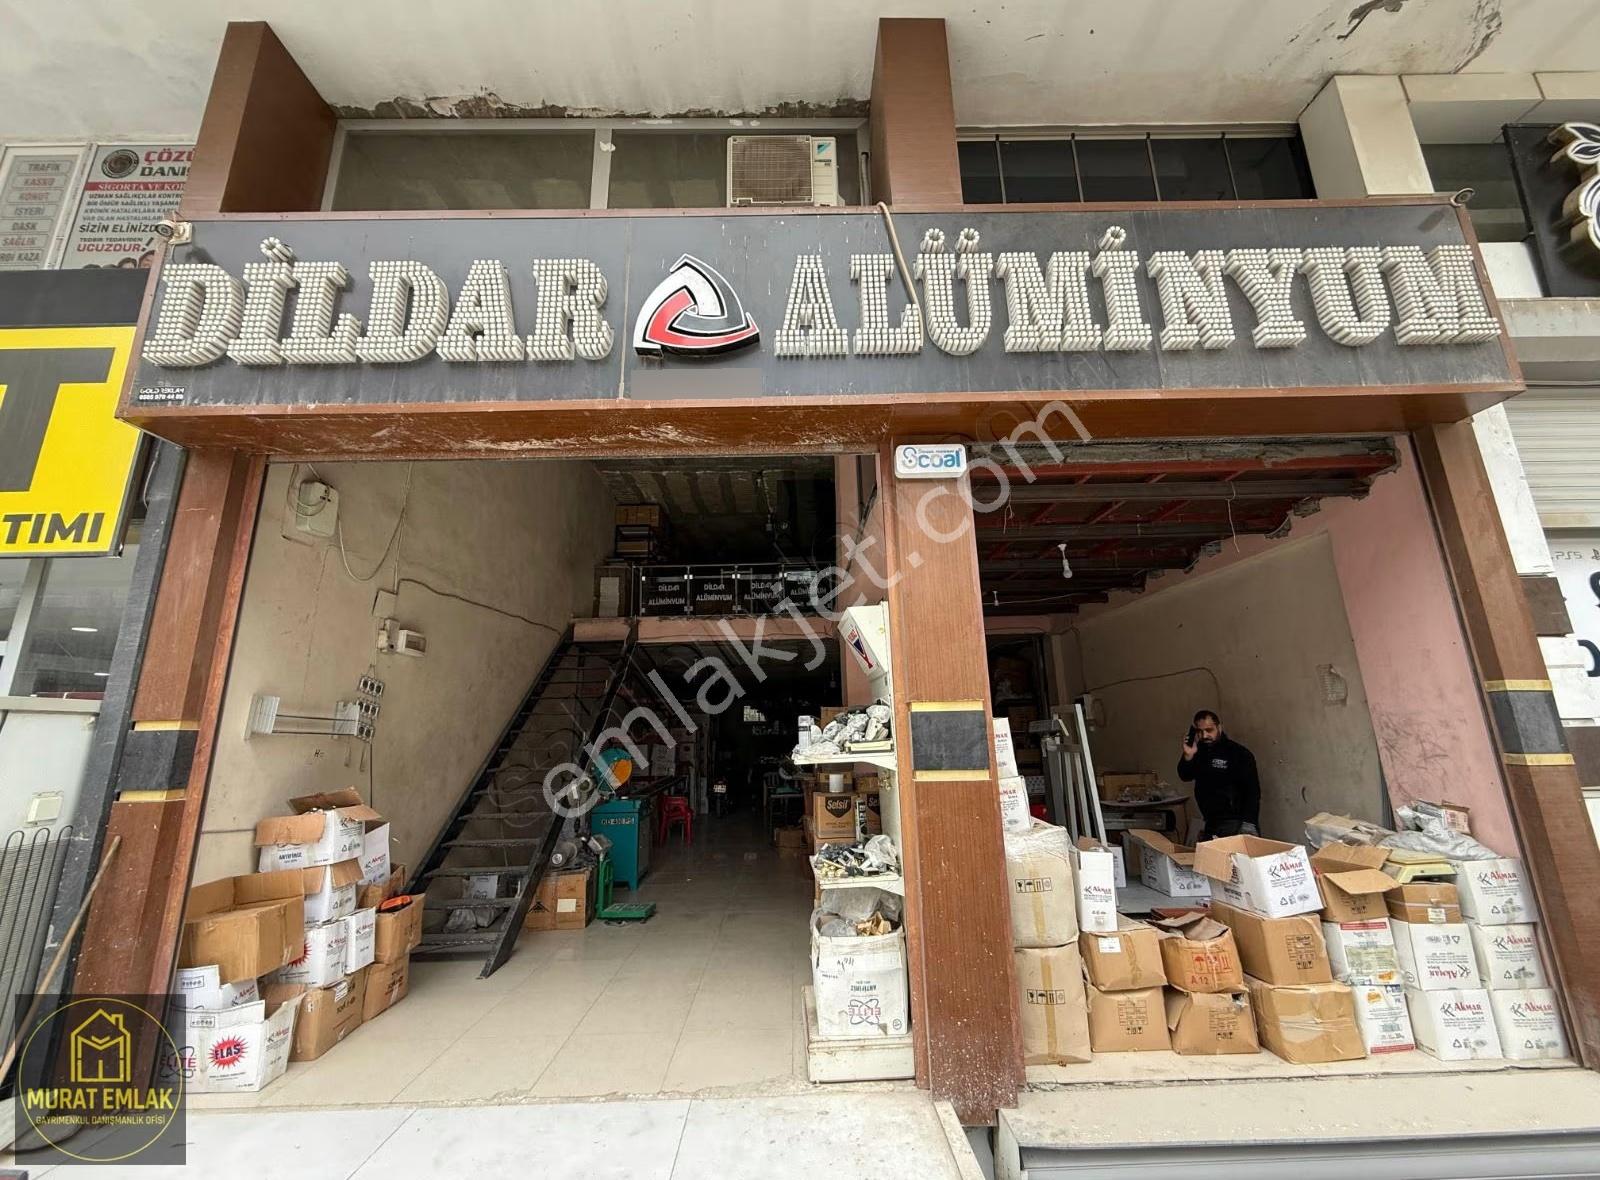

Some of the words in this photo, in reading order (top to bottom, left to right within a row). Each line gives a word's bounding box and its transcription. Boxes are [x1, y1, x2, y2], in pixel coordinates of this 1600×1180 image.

[80, 222, 109, 232] SİZİN
[142, 237, 615, 366] DİLDAR
[774, 226, 1501, 356] ALÜMİNYUM
